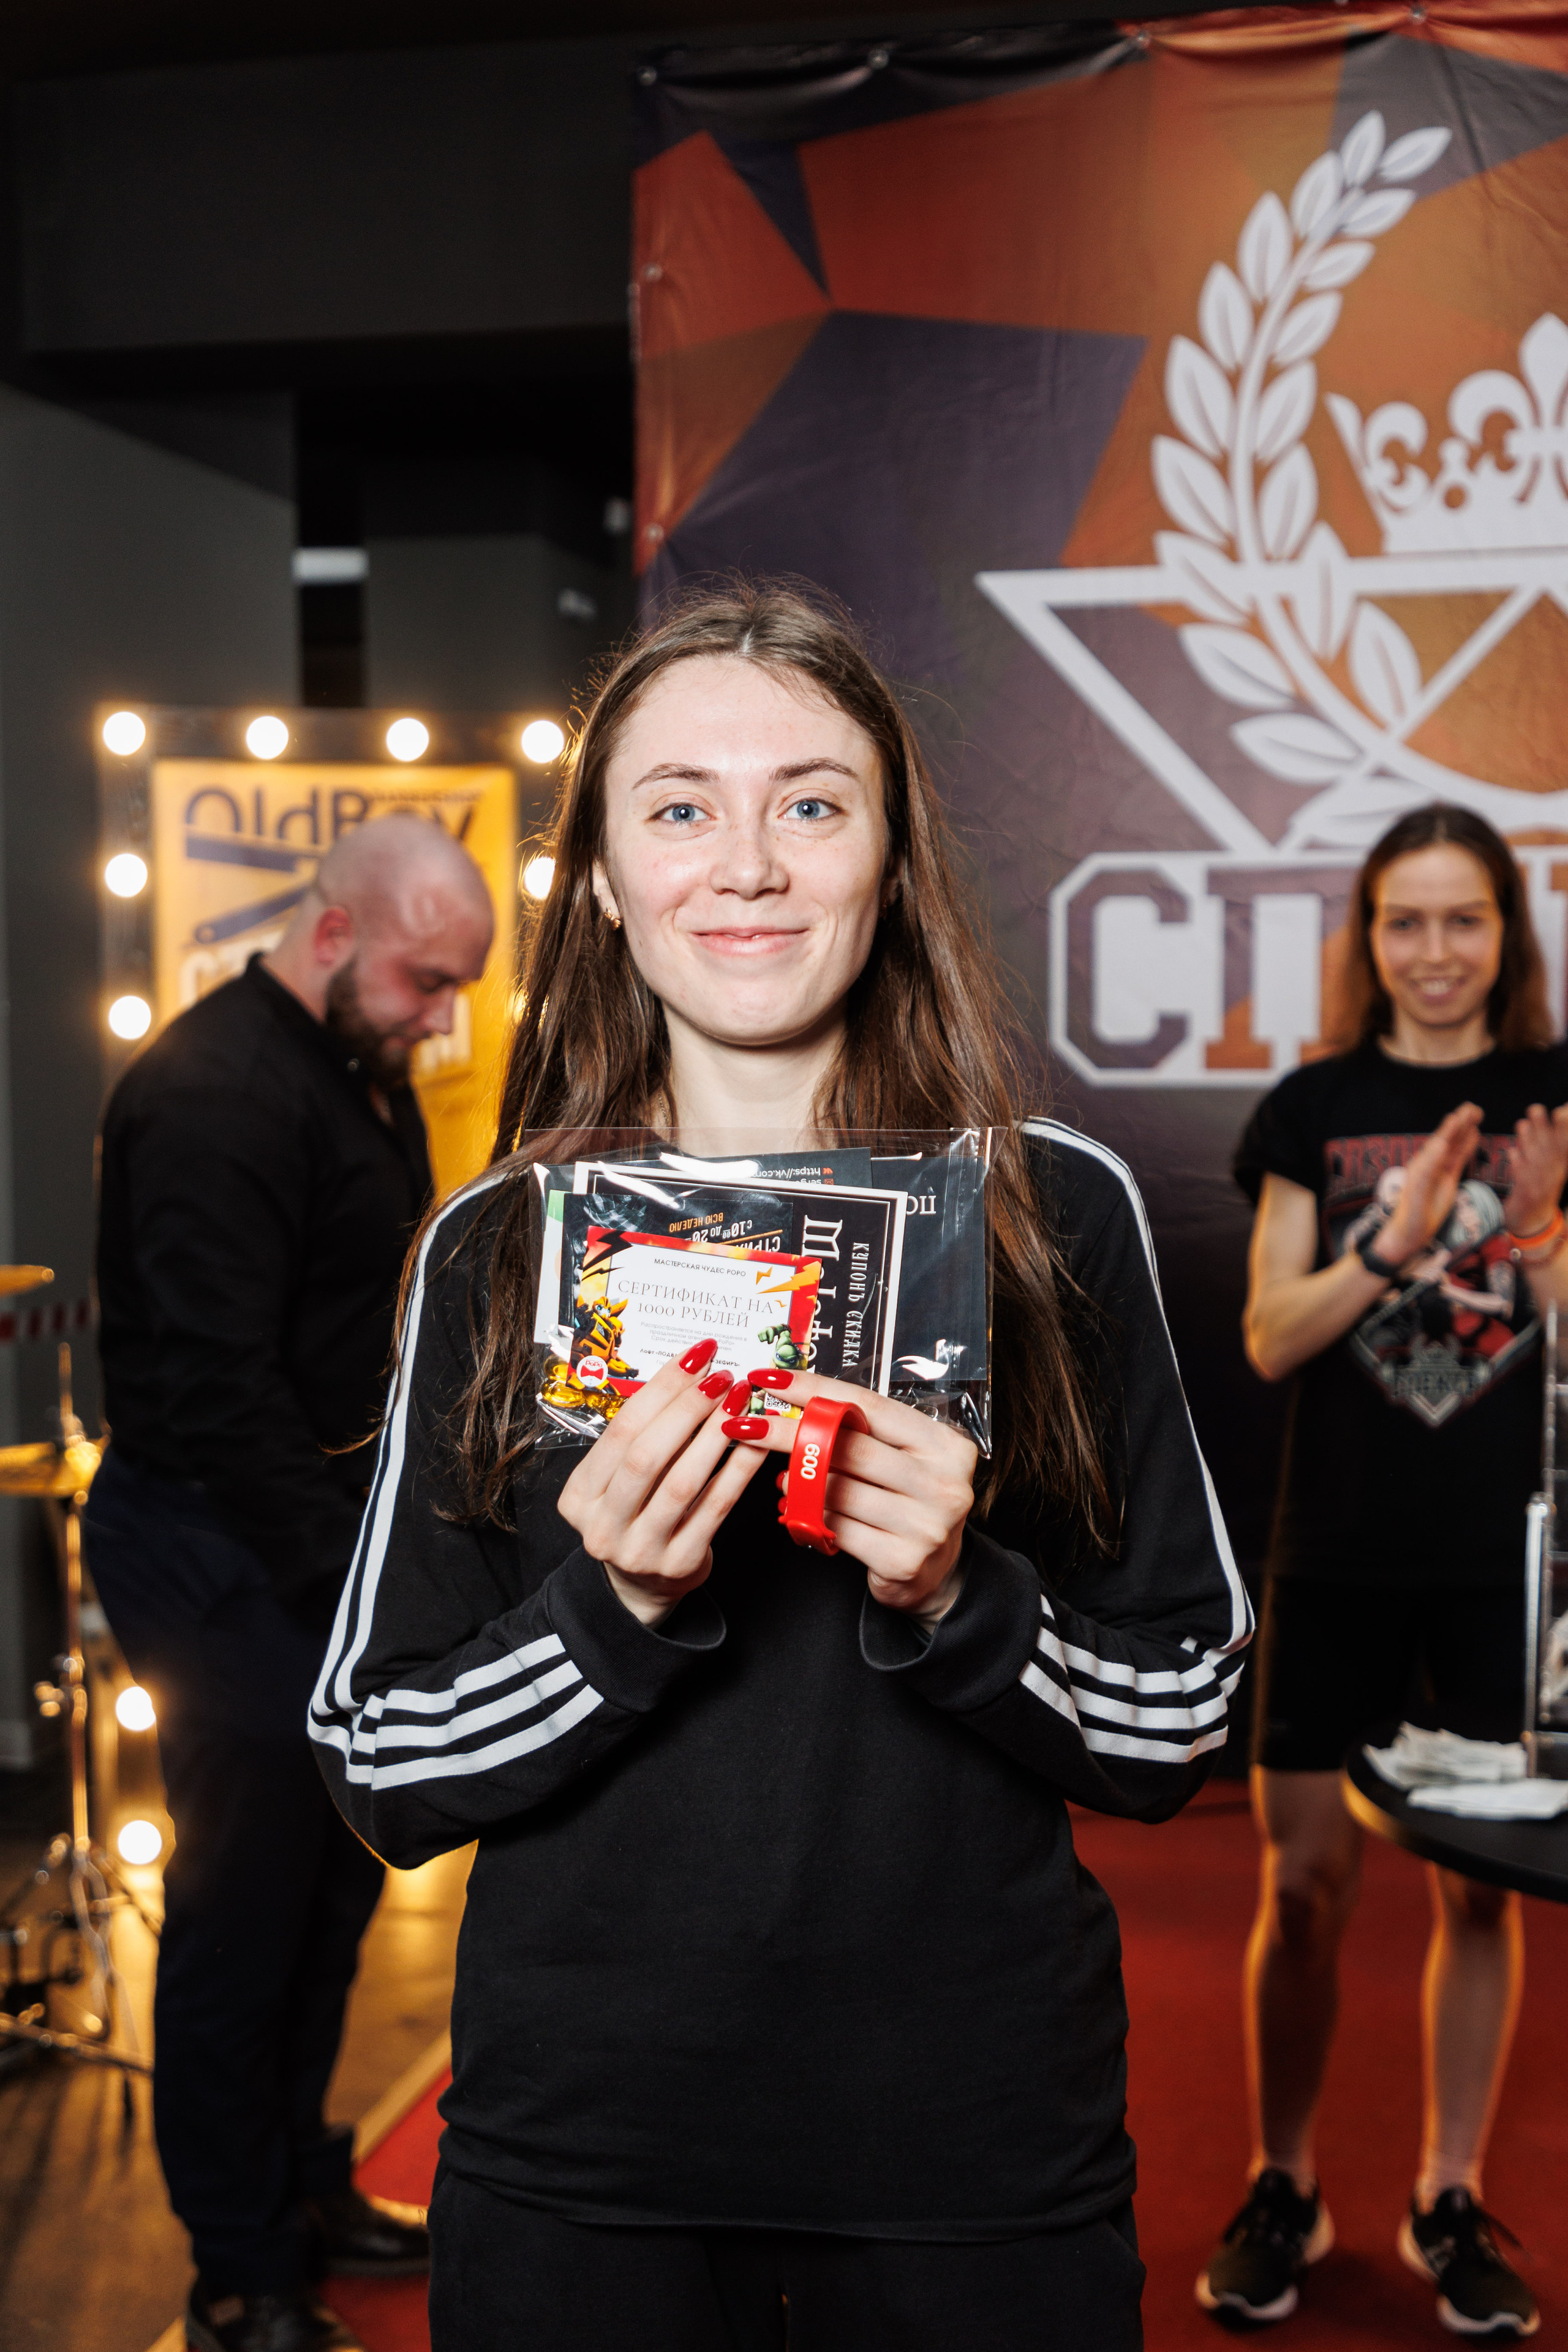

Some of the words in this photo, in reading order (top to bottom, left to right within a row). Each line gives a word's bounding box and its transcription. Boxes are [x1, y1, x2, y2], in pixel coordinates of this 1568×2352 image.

[669, 1216, 703, 1232] НЕДЕЛЮ
[706, 1212, 723, 1224] ВСЮ
[654, 1259, 700, 1270] МАСТЕРСКАЯ
[701, 1265, 725, 1274] ЧУДЕС
[848, 1242, 869, 1303] КУПОНЪ
[618, 1280, 742, 1308] СЕРТИФИКАТ
[748, 1298, 773, 1314] НА
[638, 1302, 675, 1317] 1000
[681, 1306, 749, 1328] РУБЛЕЙ
[641, 1321, 693, 1334] Распространяется
[649, 1329, 687, 1338] праздничном
[842, 1310, 863, 1367] СКИДКА
[800, 1443, 821, 1480] 600
